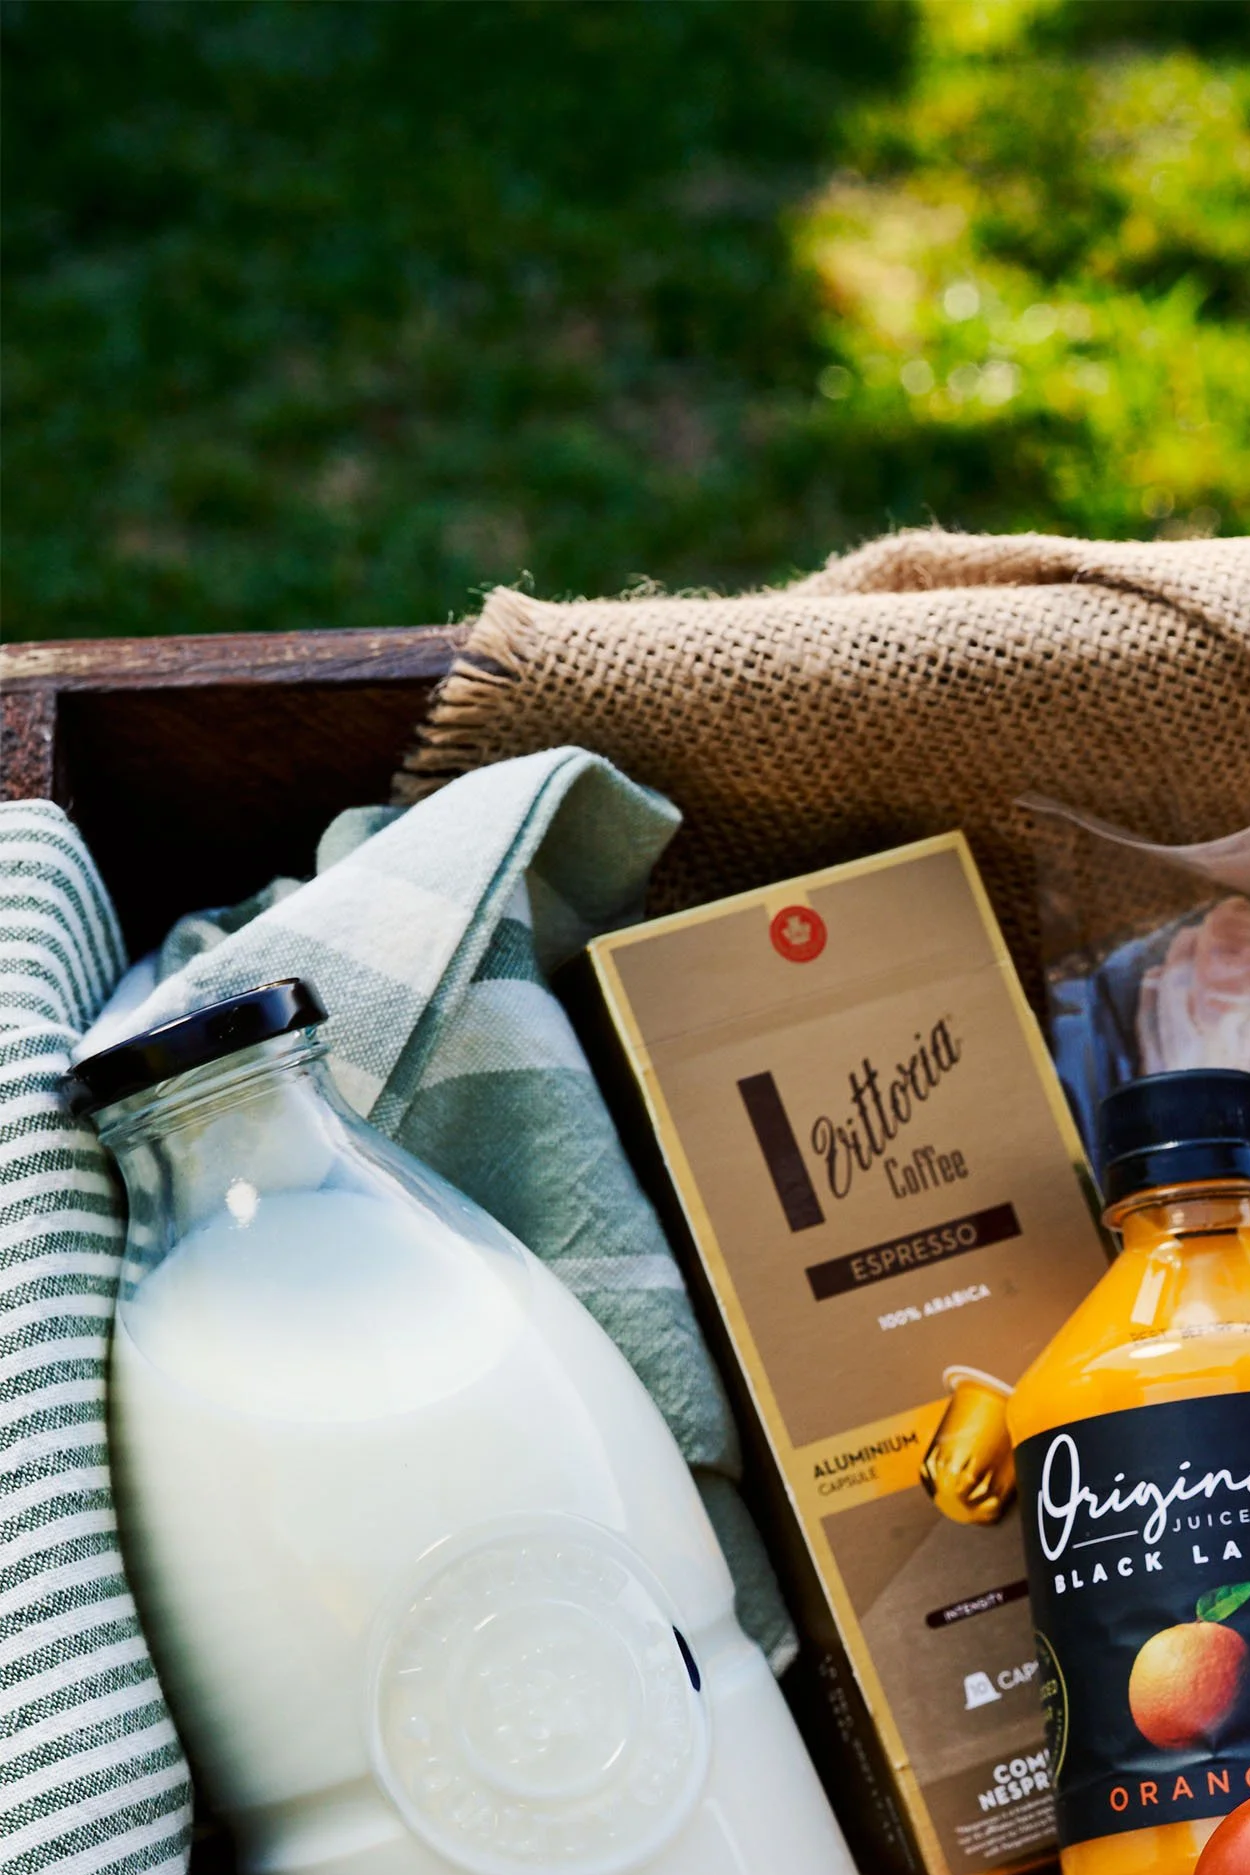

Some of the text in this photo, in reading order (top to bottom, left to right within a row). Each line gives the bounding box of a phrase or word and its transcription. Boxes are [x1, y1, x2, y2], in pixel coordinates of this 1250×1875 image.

[812, 1019, 962, 1199] Vittoria
[884, 1145, 969, 1199] Coffee
[851, 1222, 978, 1281] ESPRESSO
[877, 1283, 991, 1331] 100% ARABICA
[814, 1431, 919, 1478] ALUMINIUM
[817, 1466, 878, 1496] CAPSULE
[1173, 1508, 1250, 1531] JUICE
[1055, 1551, 1162, 1594] BLACK
[997, 1660, 1039, 1690] CAP
[993, 1748, 1049, 1784] COM
